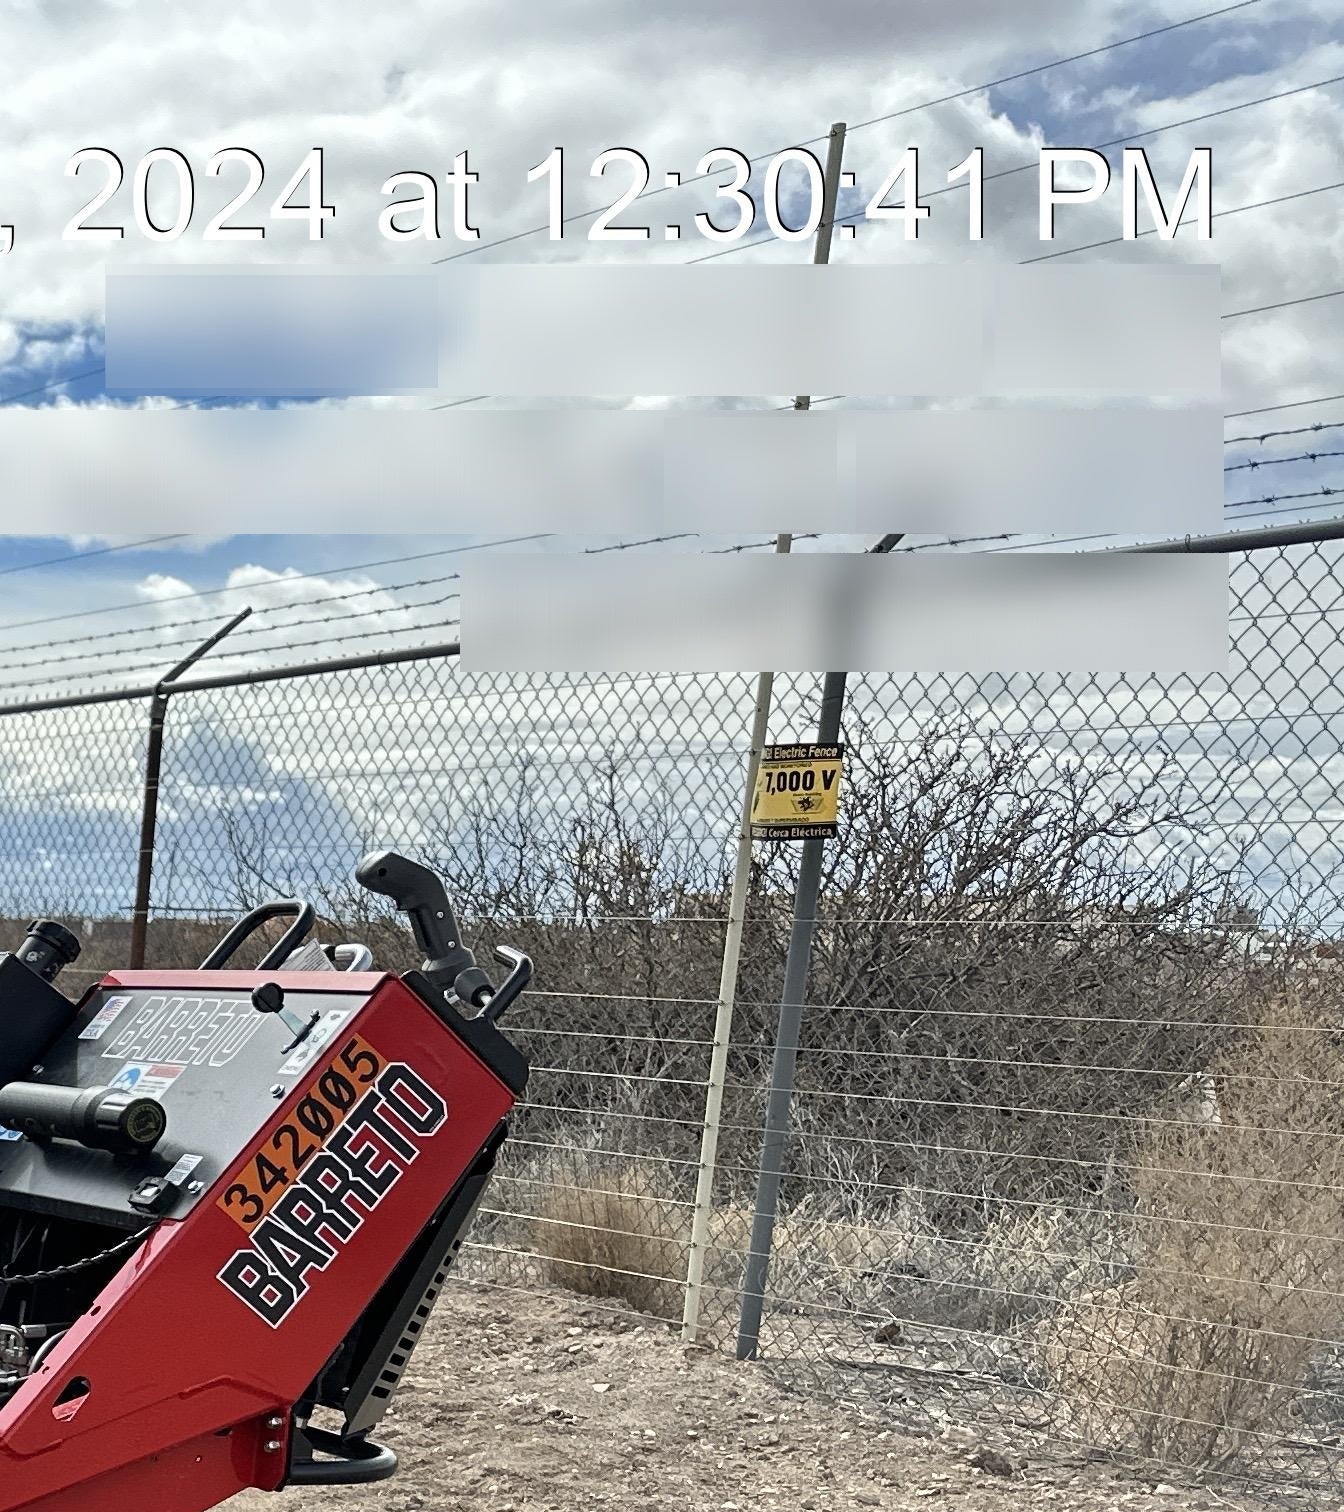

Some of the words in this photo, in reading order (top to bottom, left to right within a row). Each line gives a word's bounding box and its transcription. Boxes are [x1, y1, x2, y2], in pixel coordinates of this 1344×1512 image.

[774, 746, 807, 759] Electric
[808, 745, 838, 757] Fence
[821, 769, 837, 791] V
[768, 827, 790, 838] Cerca
[100, 995, 270, 1068] BARRETO
[215, 1061, 449, 1330] BARRETO
